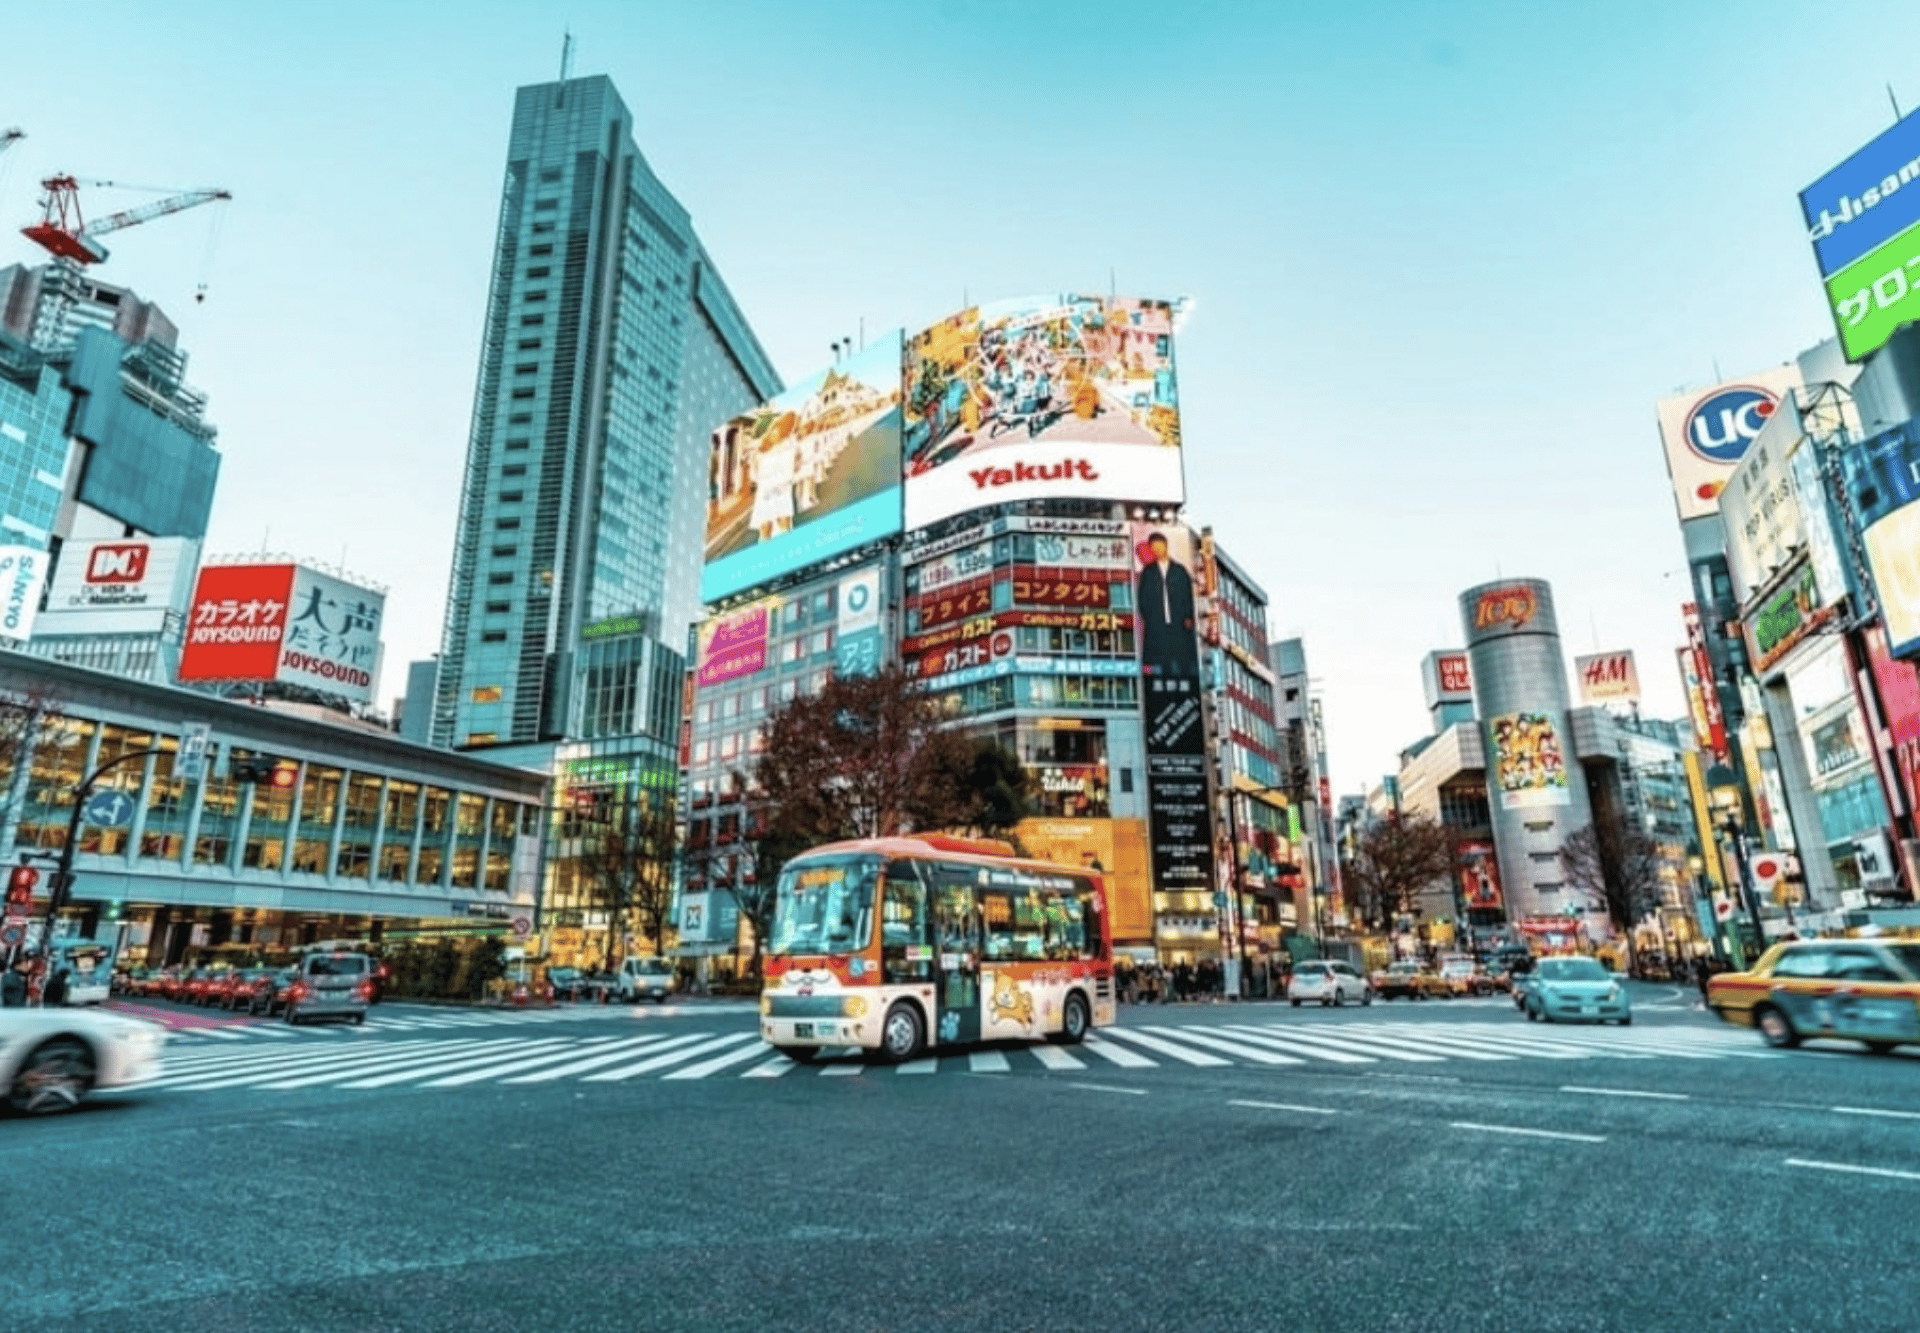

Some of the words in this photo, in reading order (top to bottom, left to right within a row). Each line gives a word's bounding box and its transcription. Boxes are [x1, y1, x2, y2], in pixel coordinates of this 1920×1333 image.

[1837, 252, 1920, 327] サロ
[968, 459, 1099, 489] Yakult
[91, 549, 141, 577] DC
[4, 554, 35, 630] SANKYO
[1013, 581, 1107, 602] コンタクト
[195, 599, 284, 624] カラオケ
[1080, 612, 1125, 630] ガスト
[1475, 596, 1537, 630] 109
[191, 625, 281, 643] JOYSOUND
[962, 617, 998, 640] ガスト
[282, 650, 371, 687] JOYSOUND
[944, 645, 988, 672] ガスト
